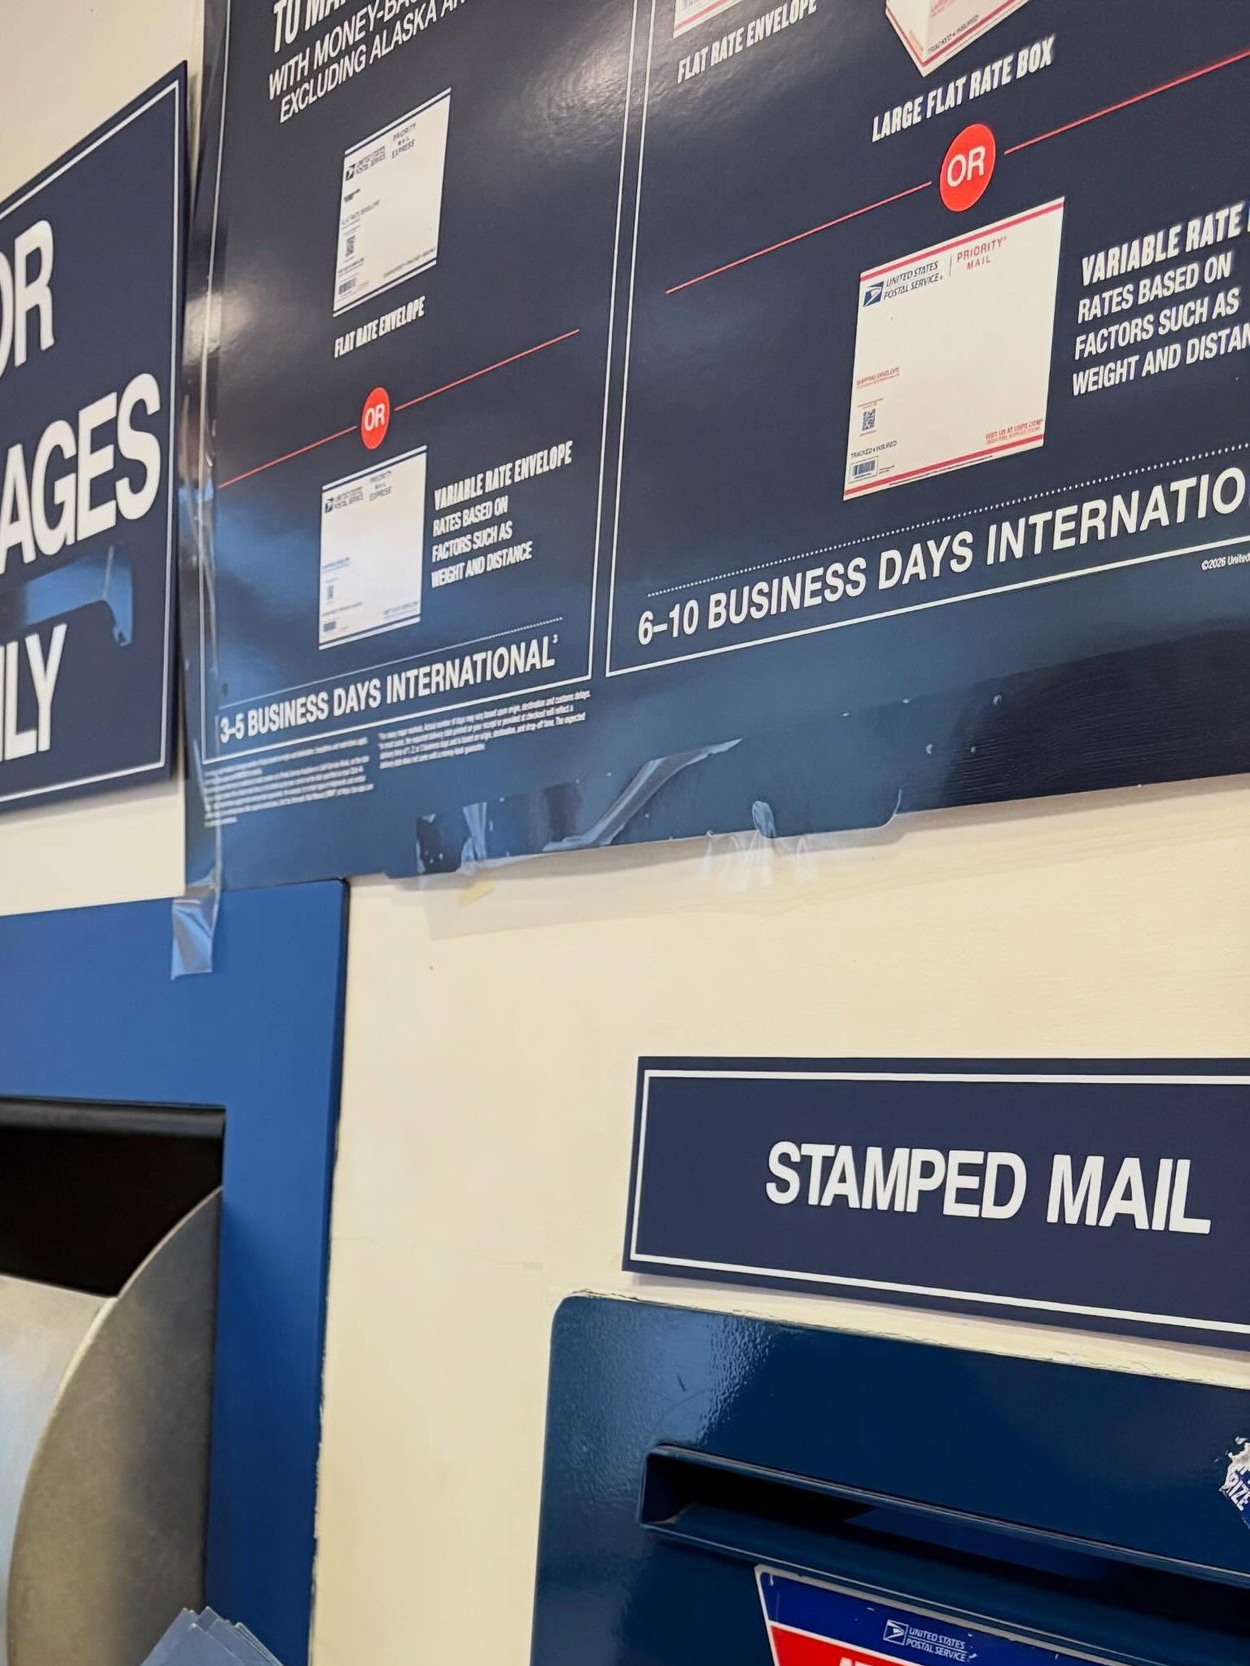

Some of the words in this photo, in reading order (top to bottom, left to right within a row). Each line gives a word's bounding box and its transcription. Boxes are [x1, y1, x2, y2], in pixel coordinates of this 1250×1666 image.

[269, 47, 310, 100] WITH
[280, 44, 366, 123] EXCLUDING
[369, 3, 437, 64] ALASKA
[677, 47, 709, 85] FLAT
[710, 29, 745, 69] RATE
[871, 96, 923, 143] LARGE
[926, 76, 966, 120] FLAT
[968, 55, 1013, 100] RATE
[1016, 34, 1056, 79] BOX
[946, 146, 986, 188] OR
[966, 257, 991, 270] MAIL
[1081, 224, 1182, 287] VARIABLE
[1185, 201, 1245, 253] RATE
[883, 283, 910, 300] POSTAL
[886, 269, 913, 287] UNITED
[913, 261, 939, 278] STATES
[1078, 284, 1134, 324] RATES
[1138, 262, 1199, 305] BASED
[1204, 250, 1233, 284] ON
[334, 330, 356, 358] FLAT
[355, 319, 378, 348] RATE
[379, 296, 426, 336] ENVELOPE
[1075, 314, 1154, 361] FACTORS
[1158, 296, 1209, 335] SUCH
[1212, 286, 1242, 320] AS
[1072, 354, 1140, 396] WEIGHT
[1142, 343, 1181, 377] AND
[364, 403, 386, 431] OR
[434, 470, 483, 511] VARIABLE
[484, 460, 513, 491] RATE
[513, 440, 573, 482] ENVELOPE
[432, 535, 472, 563] FACTORS
[472, 528, 498, 549] SUCH
[498, 521, 513, 541] AS
[433, 511, 461, 537] RATES
[462, 501, 492, 526] BASED
[492, 495, 508, 516] ON
[431, 561, 465, 588] WEIGHT
[465, 556, 485, 578] AND
[486, 541, 533, 572] DISTANCE
[707, 556, 868, 630] BUSINESS
[878, 530, 974, 590] DAYS
[247, 691, 330, 737] BUSINESS
[332, 680, 382, 717] DAYS
[766, 1141, 1026, 1220] STAMPED
[1046, 1154, 1211, 1234] MAIL
[904, 1636, 934, 1654] POSTAL
[933, 1645, 967, 1662] SERVICE
[906, 1624, 938, 1642] UNITED
[936, 1634, 966, 1650] STATES
